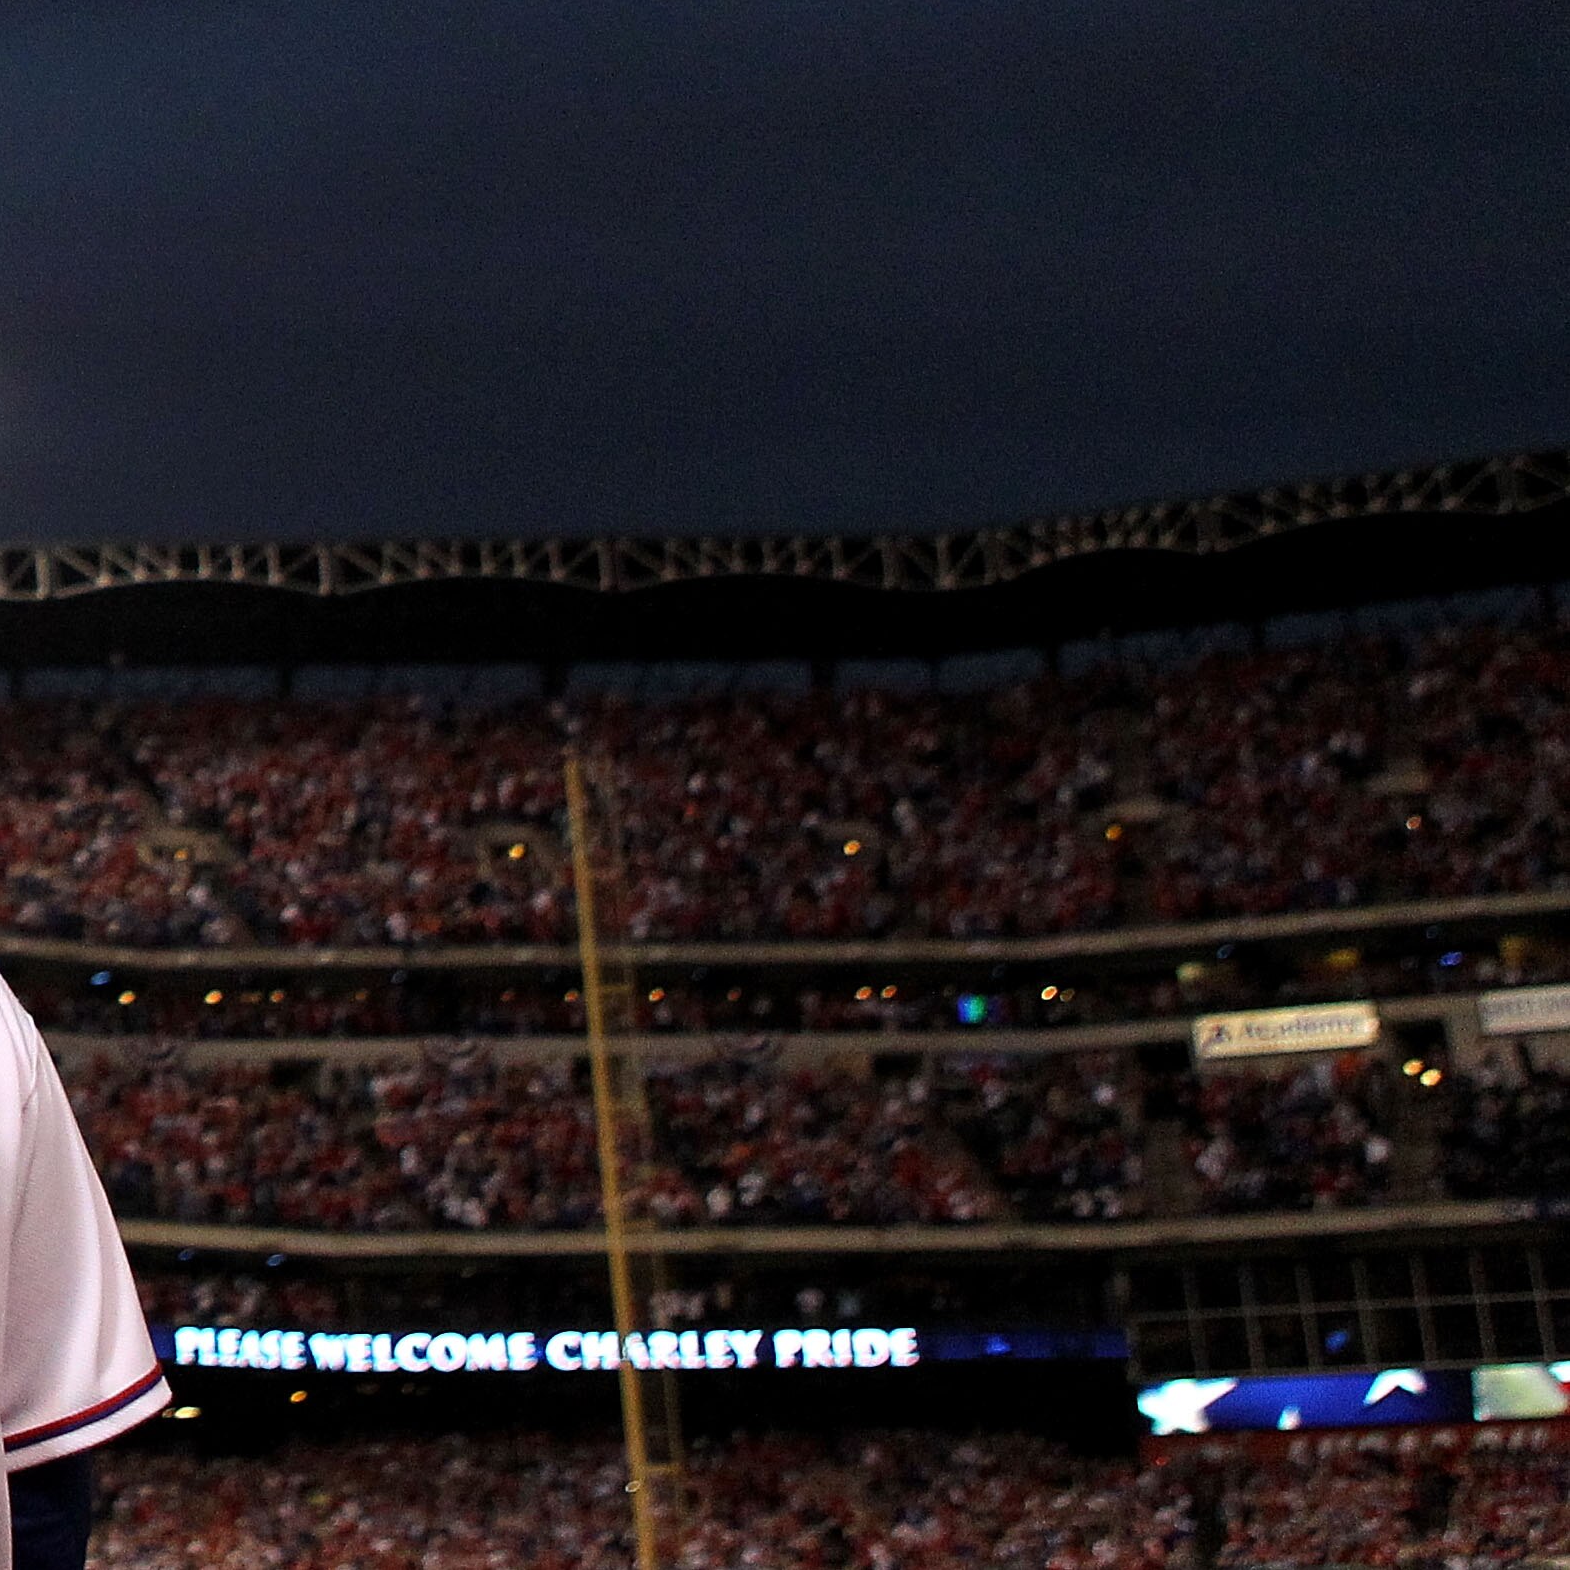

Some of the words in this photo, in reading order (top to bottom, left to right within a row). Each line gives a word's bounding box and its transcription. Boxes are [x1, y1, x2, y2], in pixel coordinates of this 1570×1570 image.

[308, 1331, 540, 1373] WELCOME
[545, 1330, 763, 1371] CHARLEY
[773, 1328, 921, 1369] PRIDE
